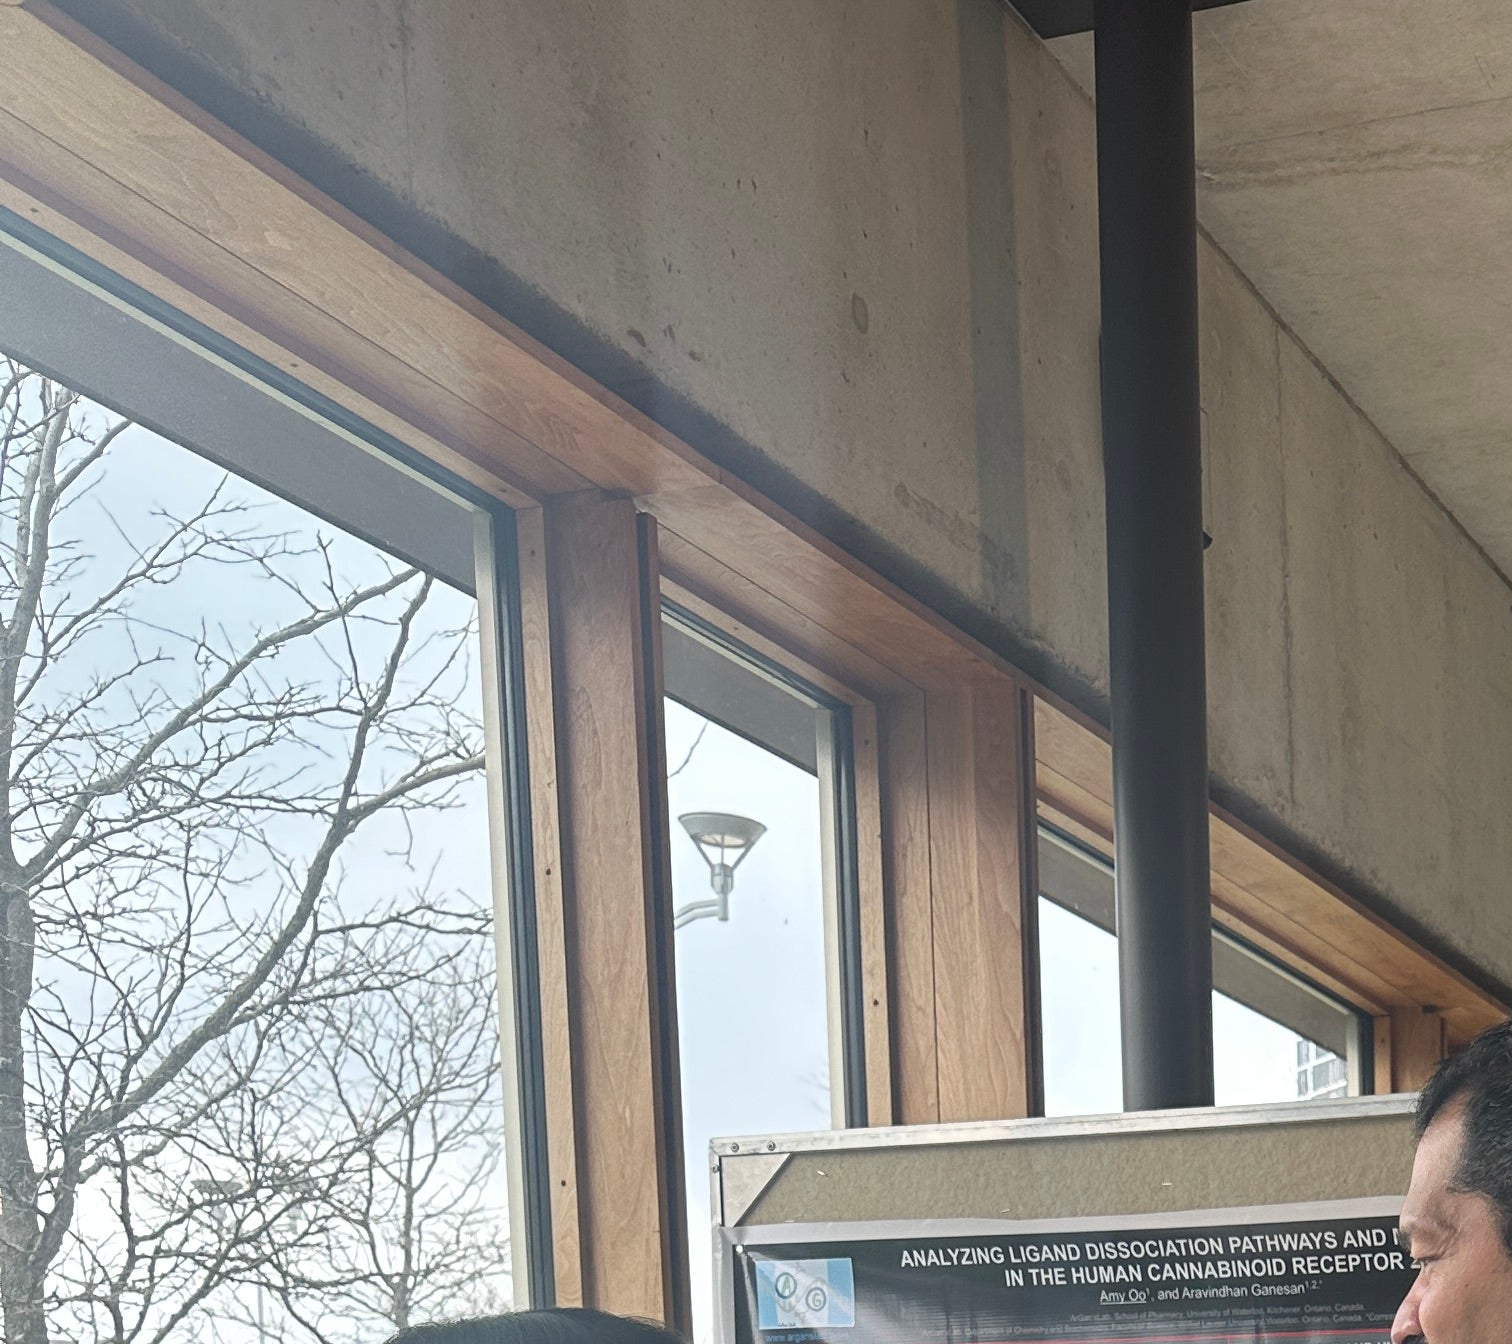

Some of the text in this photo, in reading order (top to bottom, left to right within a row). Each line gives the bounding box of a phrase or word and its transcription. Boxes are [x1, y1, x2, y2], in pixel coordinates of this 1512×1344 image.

[901, 1247, 1004, 1267] ANALYZING
[1009, 1244, 1081, 1263] LIGAND
[1085, 1238, 1223, 1260] DISSOCIATION
[1229, 1231, 1337, 1253] PATHWAYS
[1343, 1229, 1386, 1248] AND
[1005, 1252, 1404, 1287] IN THE HUMAN CANNABINOID RECEPTOR
[1100, 1290, 1125, 1303] Amy
[1157, 1288, 1179, 1299] and
[1182, 1287, 1247, 1299] Aravindhan
